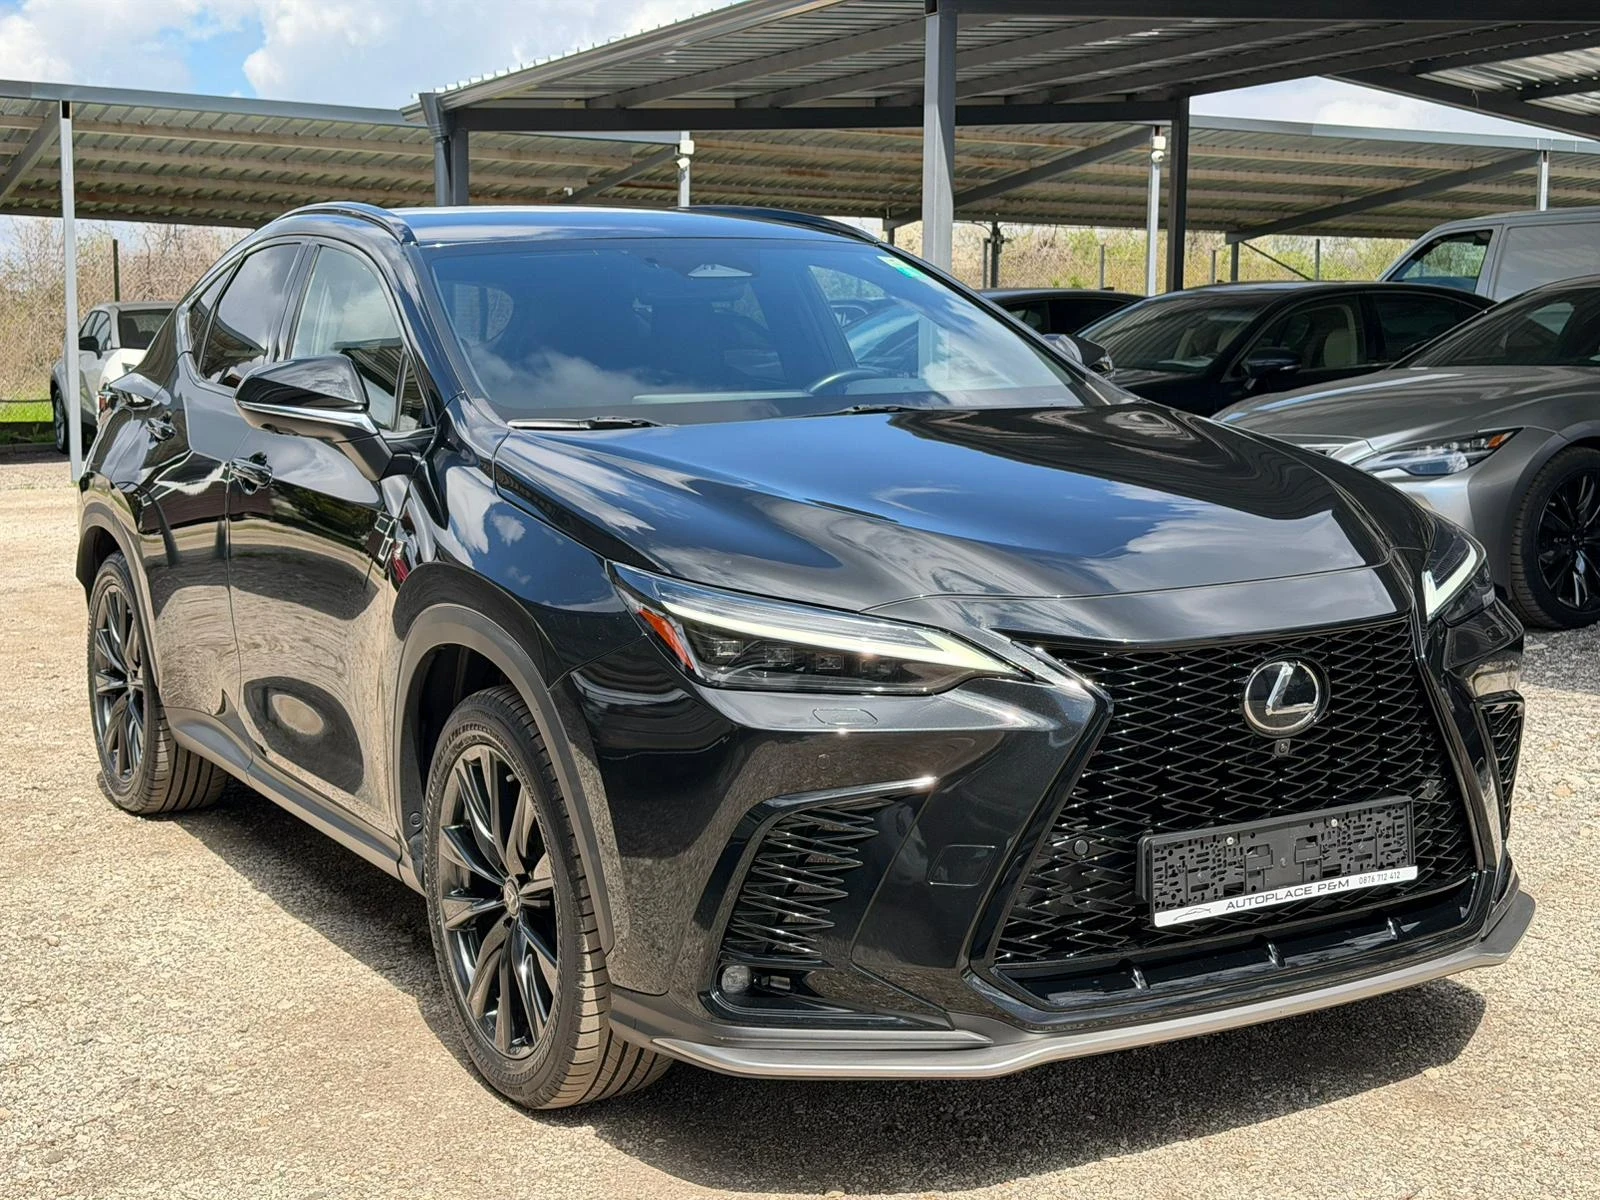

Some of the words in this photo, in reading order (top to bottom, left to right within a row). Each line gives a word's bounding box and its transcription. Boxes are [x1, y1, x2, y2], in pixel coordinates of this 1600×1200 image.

[1226, 886, 1312, 911] AUTOPLACE
[1317, 879, 1350, 893] P&M
[1358, 875, 1376, 885] 0876
[1377, 873, 1388, 881] 712
[1389, 871, 1401, 879] 412
